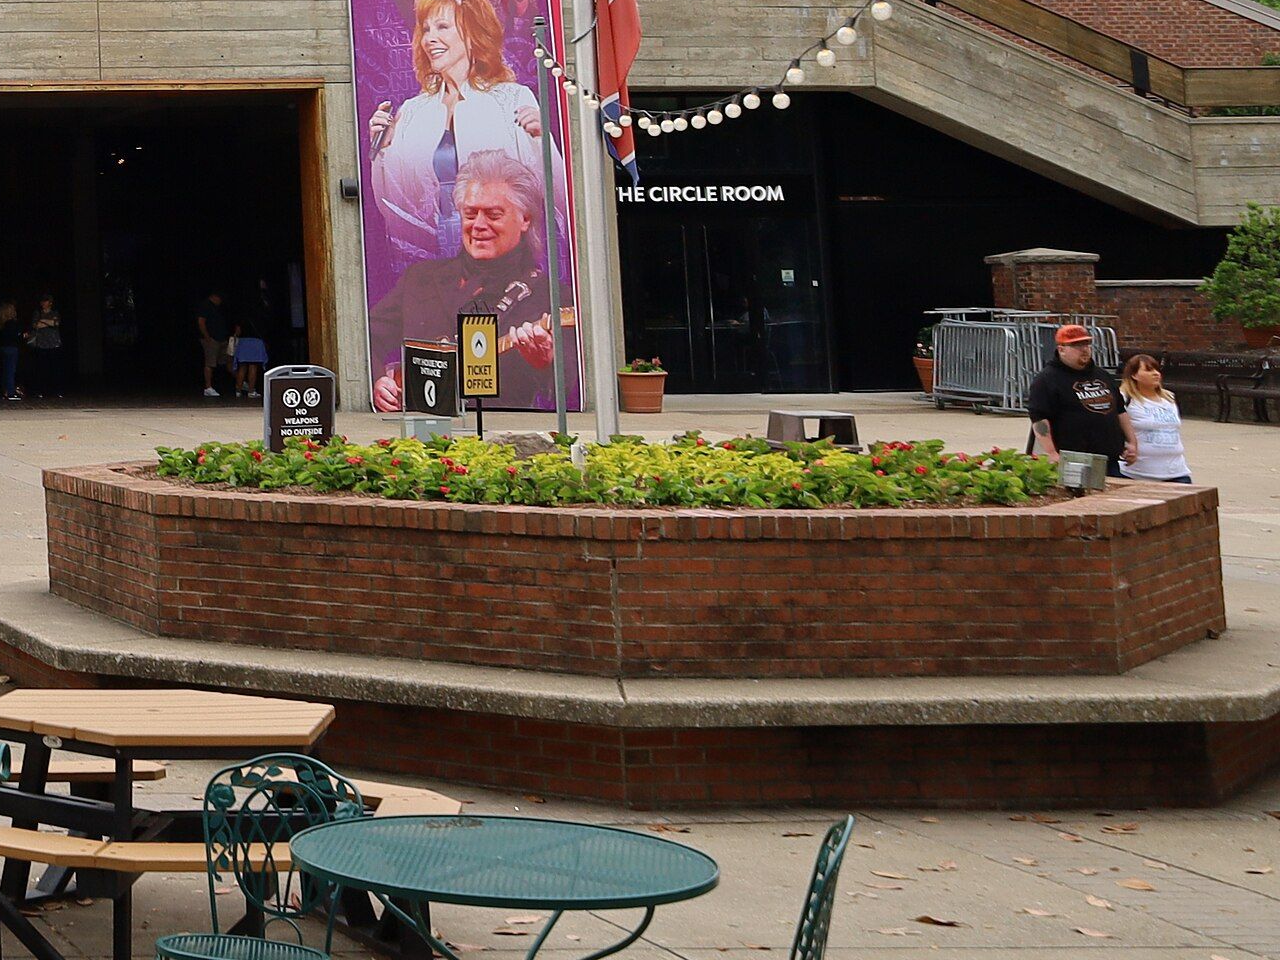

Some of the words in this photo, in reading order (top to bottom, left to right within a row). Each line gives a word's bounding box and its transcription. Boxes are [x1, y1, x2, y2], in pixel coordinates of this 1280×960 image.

[616, 186, 646, 202] HE
[649, 186, 718, 202] CIRCLE
[721, 185, 785, 202] ROOM
[467, 365, 491, 376] TICKET
[466, 378, 493, 389] OFFICE
[293, 428, 323, 436] OUTSIDE
